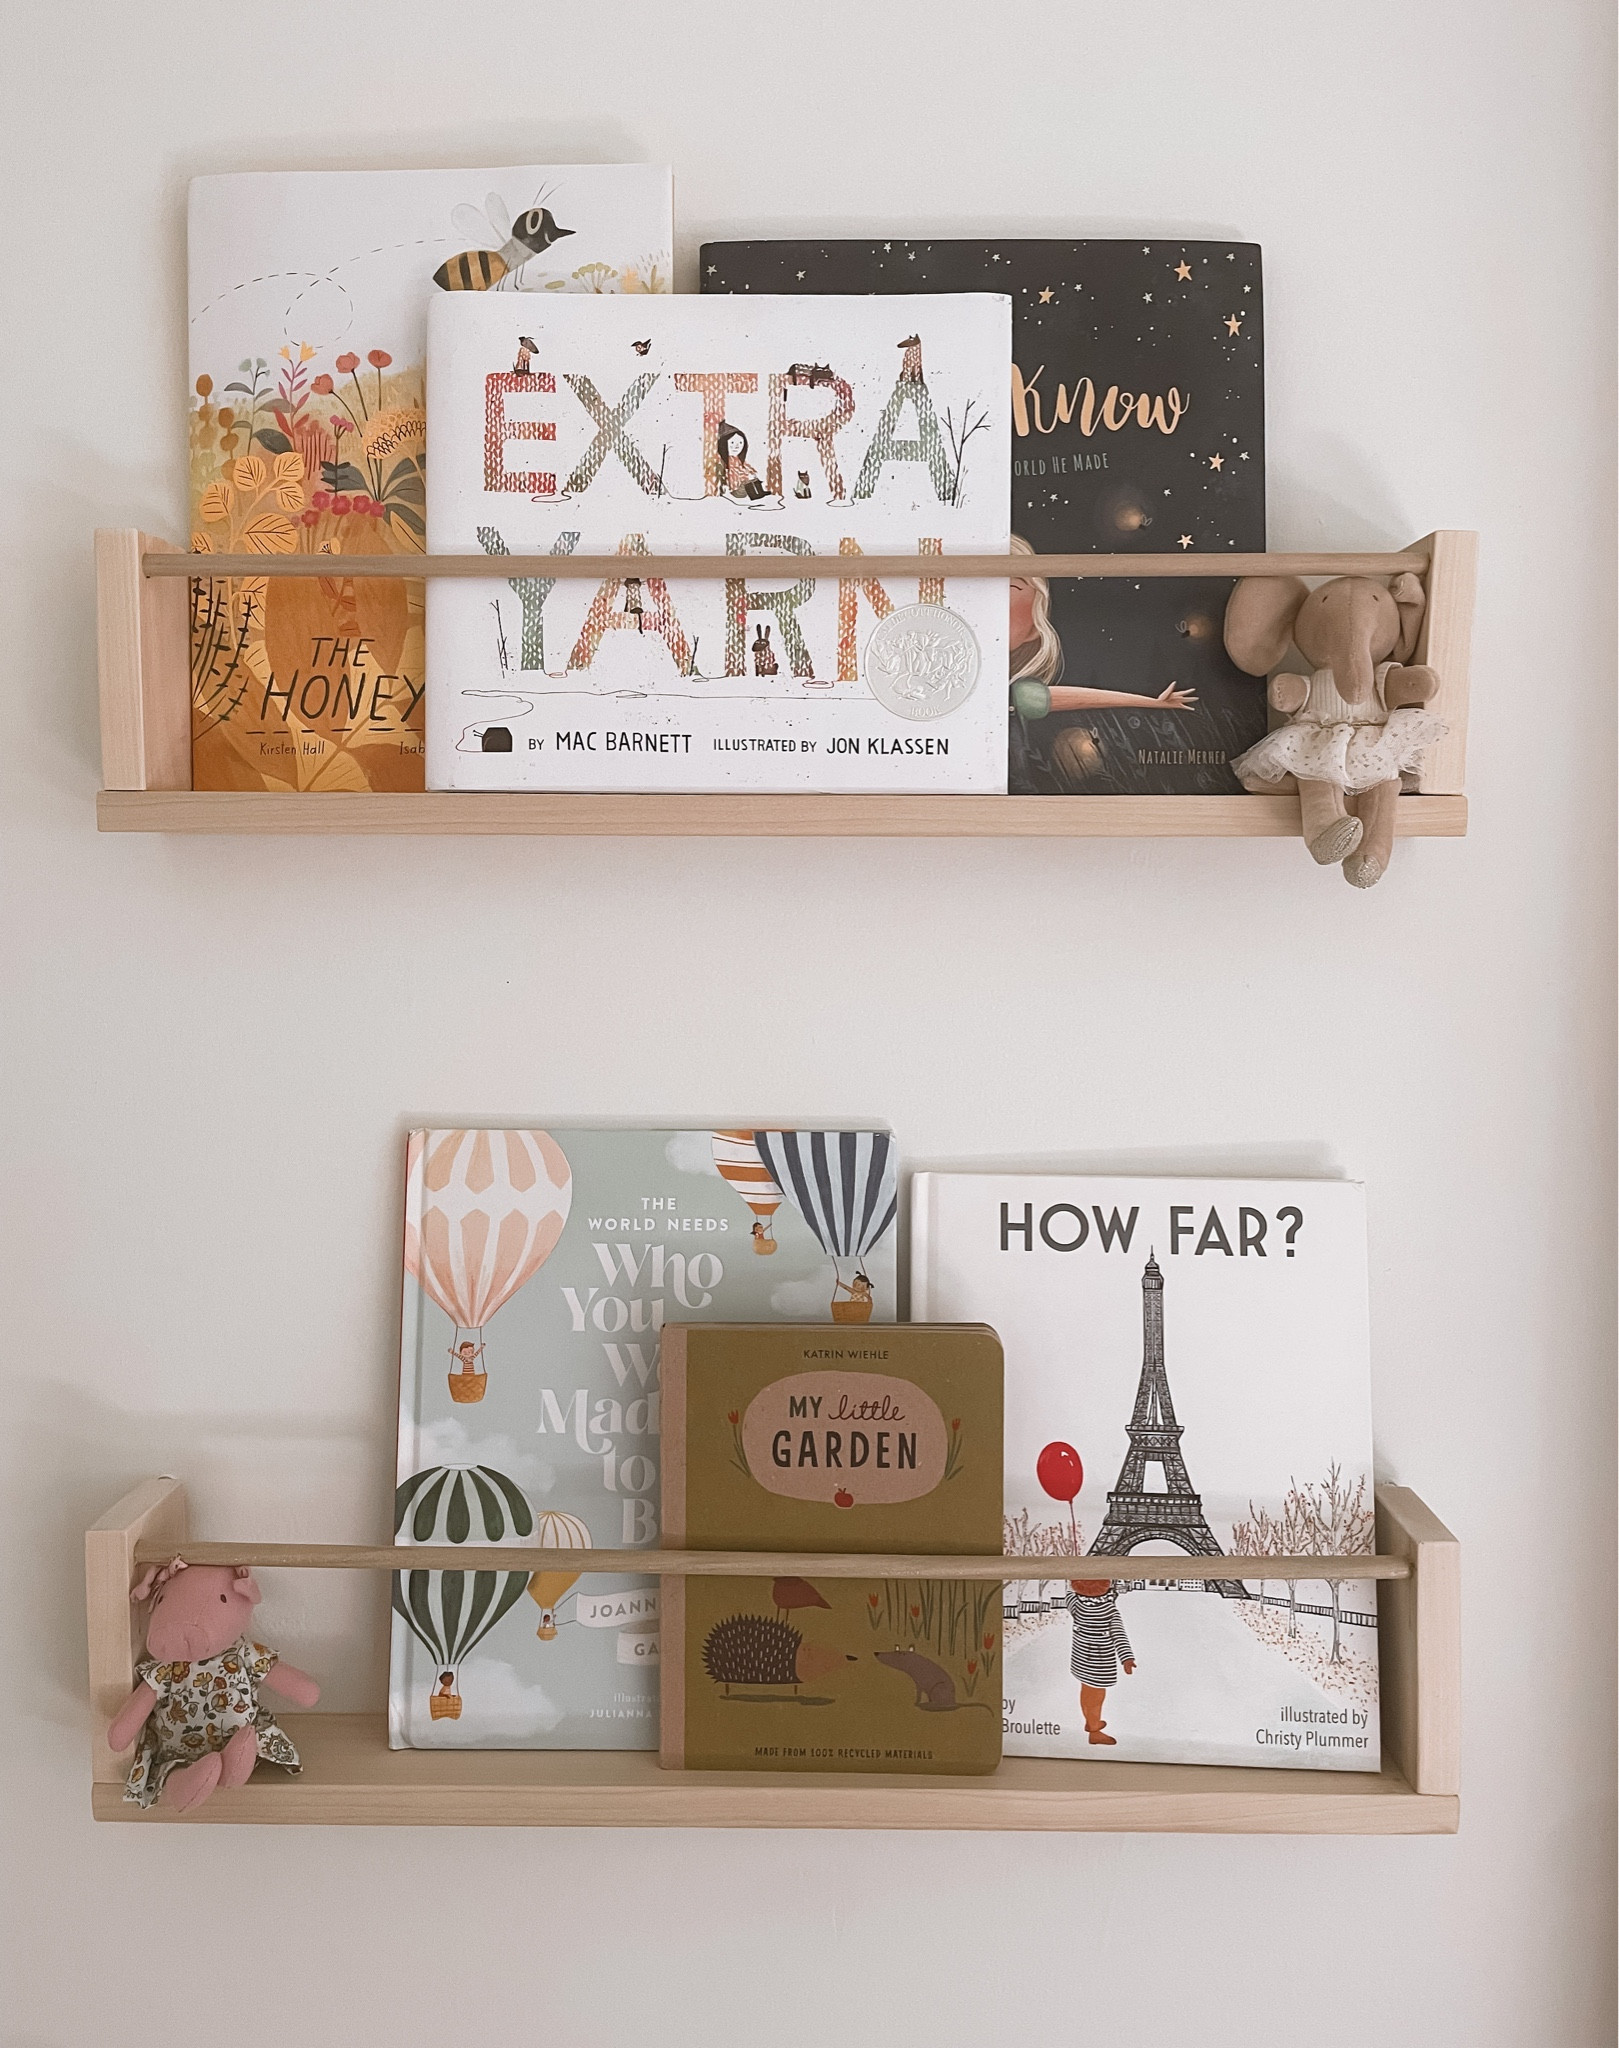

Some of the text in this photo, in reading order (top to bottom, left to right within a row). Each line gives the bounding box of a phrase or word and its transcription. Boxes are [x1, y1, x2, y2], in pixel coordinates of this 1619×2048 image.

[1011, 362, 1190, 437] Know
[483, 371, 955, 501] EXTRA
[476, 527, 945, 681] YARN
[311, 637, 375, 667] THE
[260, 741, 325, 756] Kirsten Hall
[528, 731, 949, 756] BY MAC BARNETT ILLUSTRATED BY JON KLASSEN
[641, 1197, 677, 1210] THE
[588, 1218, 729, 1232] WORLD NEEDS
[1000, 1202, 1304, 1258] HOW FAR?
[591, 1243, 724, 1309] Who
[560, 1287, 664, 1333] You
[602, 1343, 660, 1388] W
[803, 1350, 889, 1360] KATRIN WIEHLE
[789, 1394, 906, 1421] MY little
[772, 1430, 917, 1469] GARDEN
[601, 1445, 657, 1492] to
[1002, 1718, 1061, 1735] Broulette
[1280, 1706, 1368, 1729] illustrated by
[755, 1747, 778, 1757] MADE
[783, 1747, 806, 1757] FROM
[838, 1748, 881, 1759] RECYCLED
[885, 1749, 933, 1760] MATERIALS
[1256, 1728, 1369, 1751] Christy Plummer
